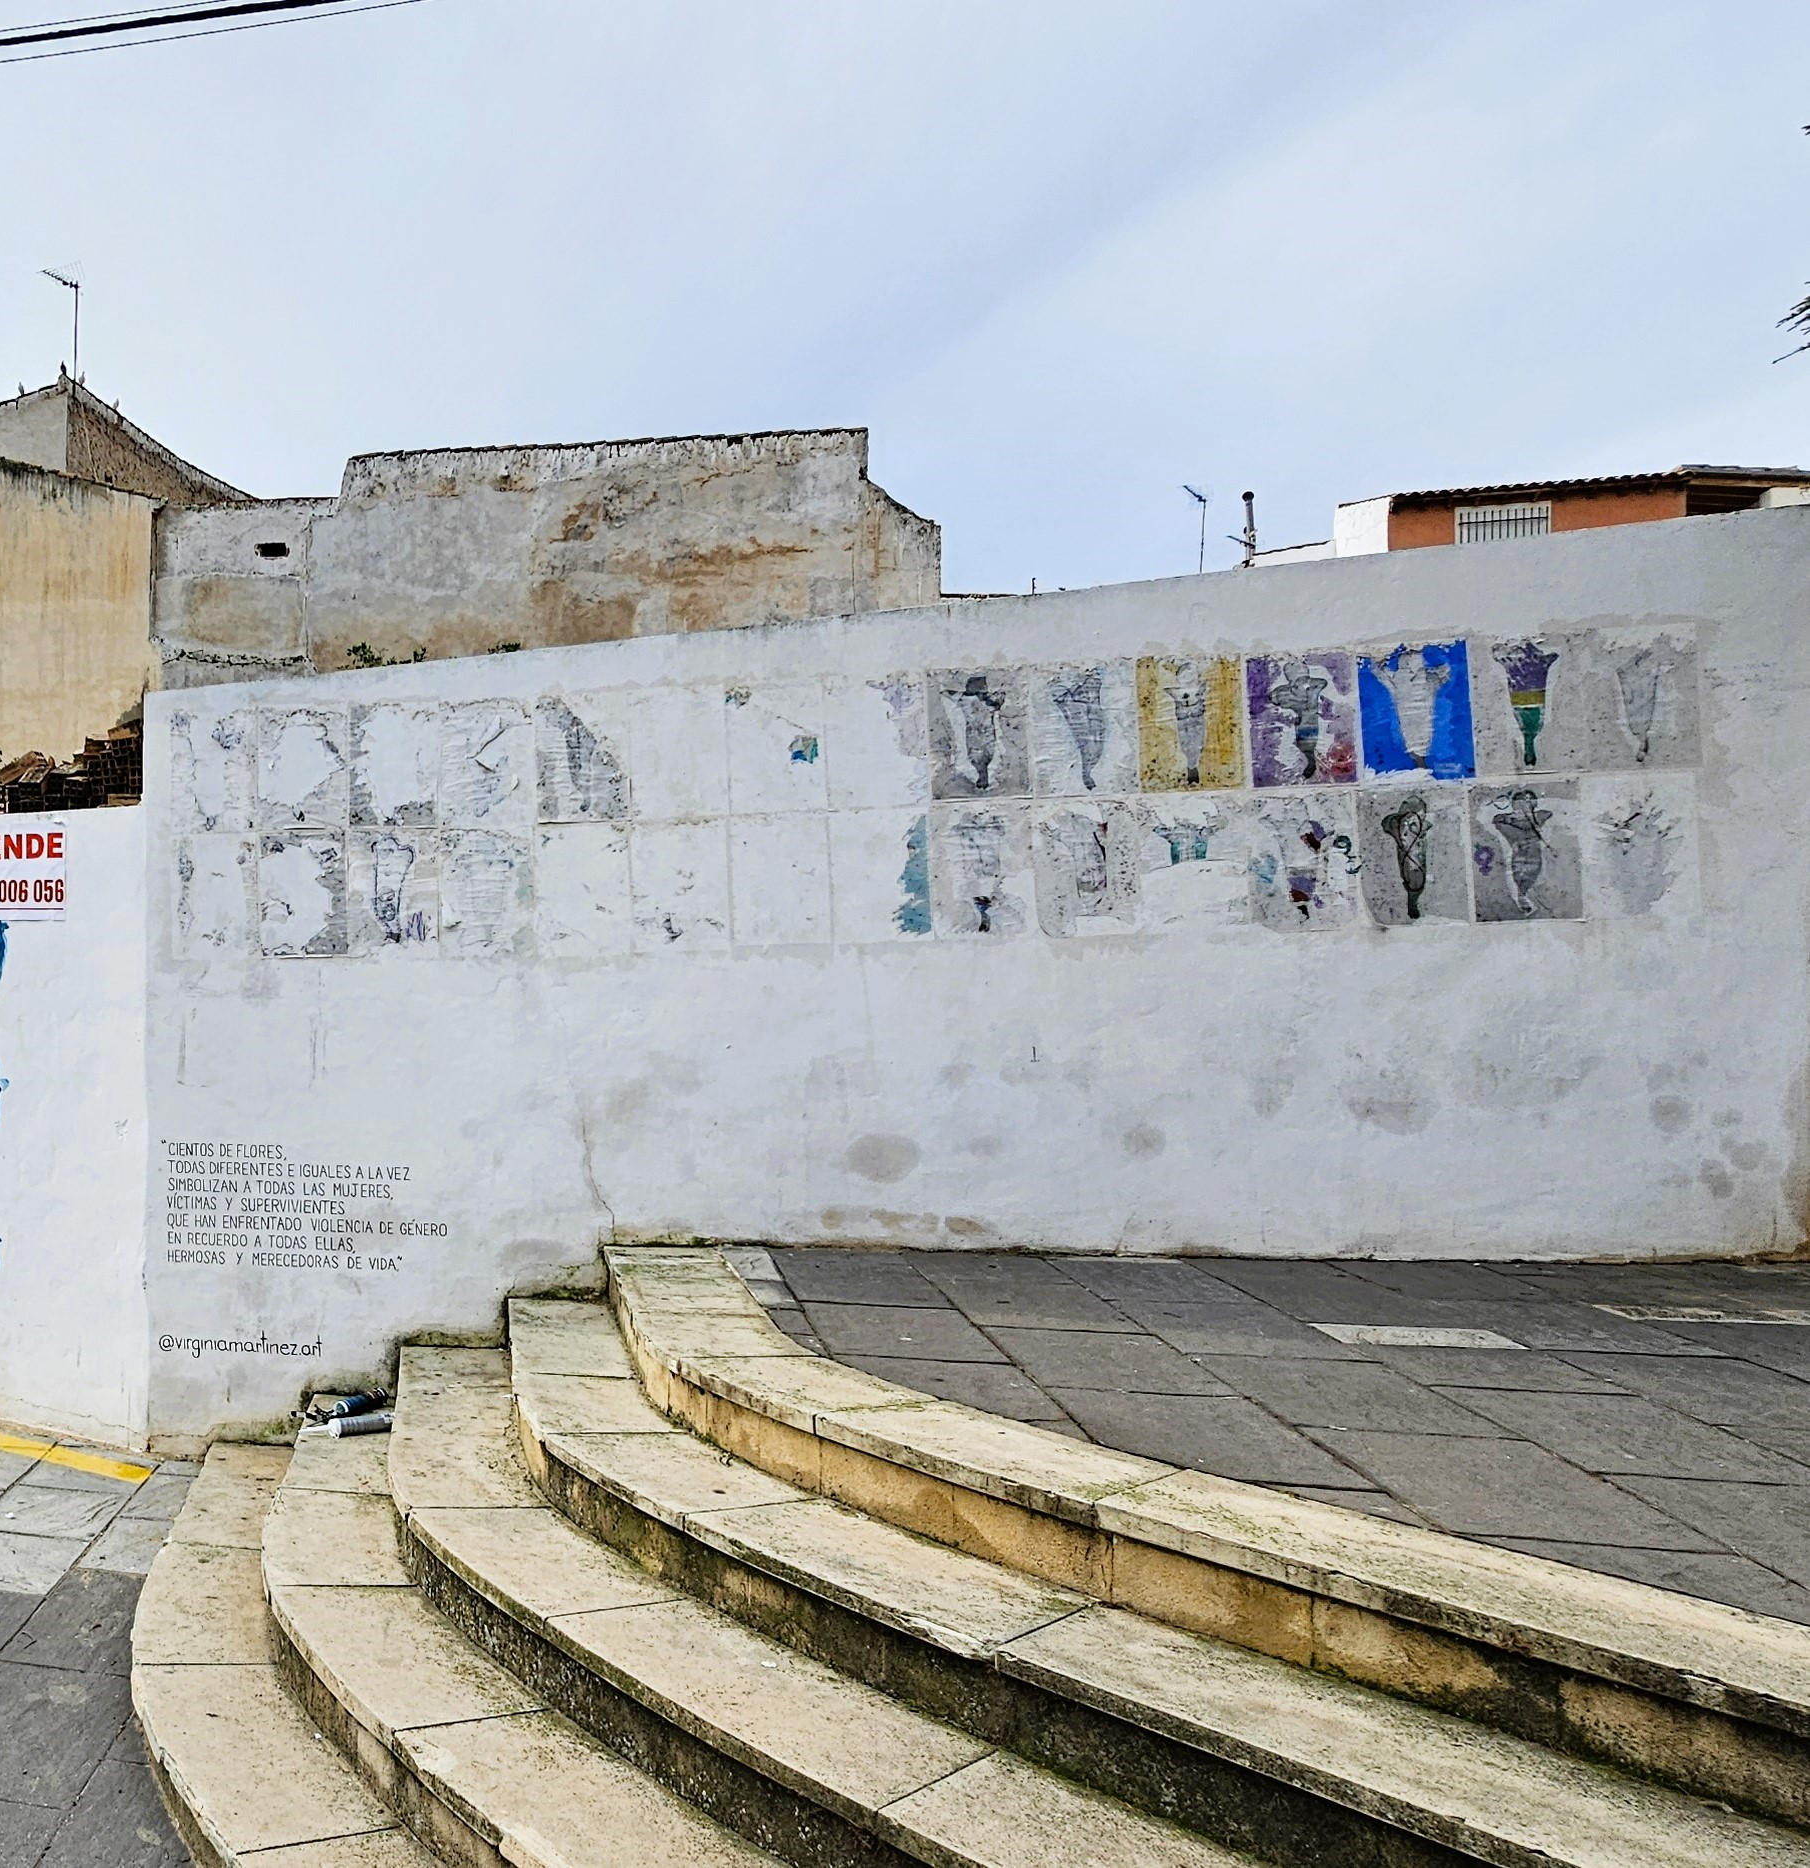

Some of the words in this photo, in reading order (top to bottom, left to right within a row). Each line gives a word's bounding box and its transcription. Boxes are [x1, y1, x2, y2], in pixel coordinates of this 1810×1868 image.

[33, 879, 64, 903] 056
[219, 1143, 233, 1157] DE
[236, 1144, 287, 1160] FLORES,
[167, 1159, 205, 1174] TODAS
[209, 1161, 283, 1177] DIFERENTES
[287, 1163, 295, 1177] E
[299, 1163, 351, 1179] IGUALES
[355, 1165, 364, 1179] A
[368, 1166, 383, 1180] LA
[386, 1166, 411, 1181] VEZ
[168, 1177, 238, 1192] SIMBOLIZAN
[243, 1180, 251, 1193] A
[256, 1180, 295, 1195] TODAS
[303, 1182, 325, 1196] LAS
[333, 1183, 394, 1200] MUJERES,
[166, 1193, 217, 1210] VÍCTIMAS
[225, 1197, 233, 1211] Y
[241, 1197, 345, 1215] SUPERVIVIENTES
[167, 1213, 189, 1229] QUE
[194, 1214, 216, 1228] HAN
[222, 1214, 302, 1231] ENFRENTADO
[311, 1218, 373, 1234] VIOLENCIA
[379, 1221, 394, 1235] DE
[400, 1219, 448, 1237] GÉNERO
[167, 1231, 181, 1244] EN
[187, 1232, 247, 1247] RECUERDO
[254, 1235, 262, 1248] A
[268, 1235, 307, 1249] TODAS
[315, 1236, 356, 1254] ELLAS,
[167, 1249, 225, 1265] HERMOSAS
[236, 1252, 243, 1265] Y
[252, 1252, 339, 1269] MERECEDORAS
[347, 1256, 362, 1269] DE
[159, 1330, 322, 1359] @virginiamartinez.art
